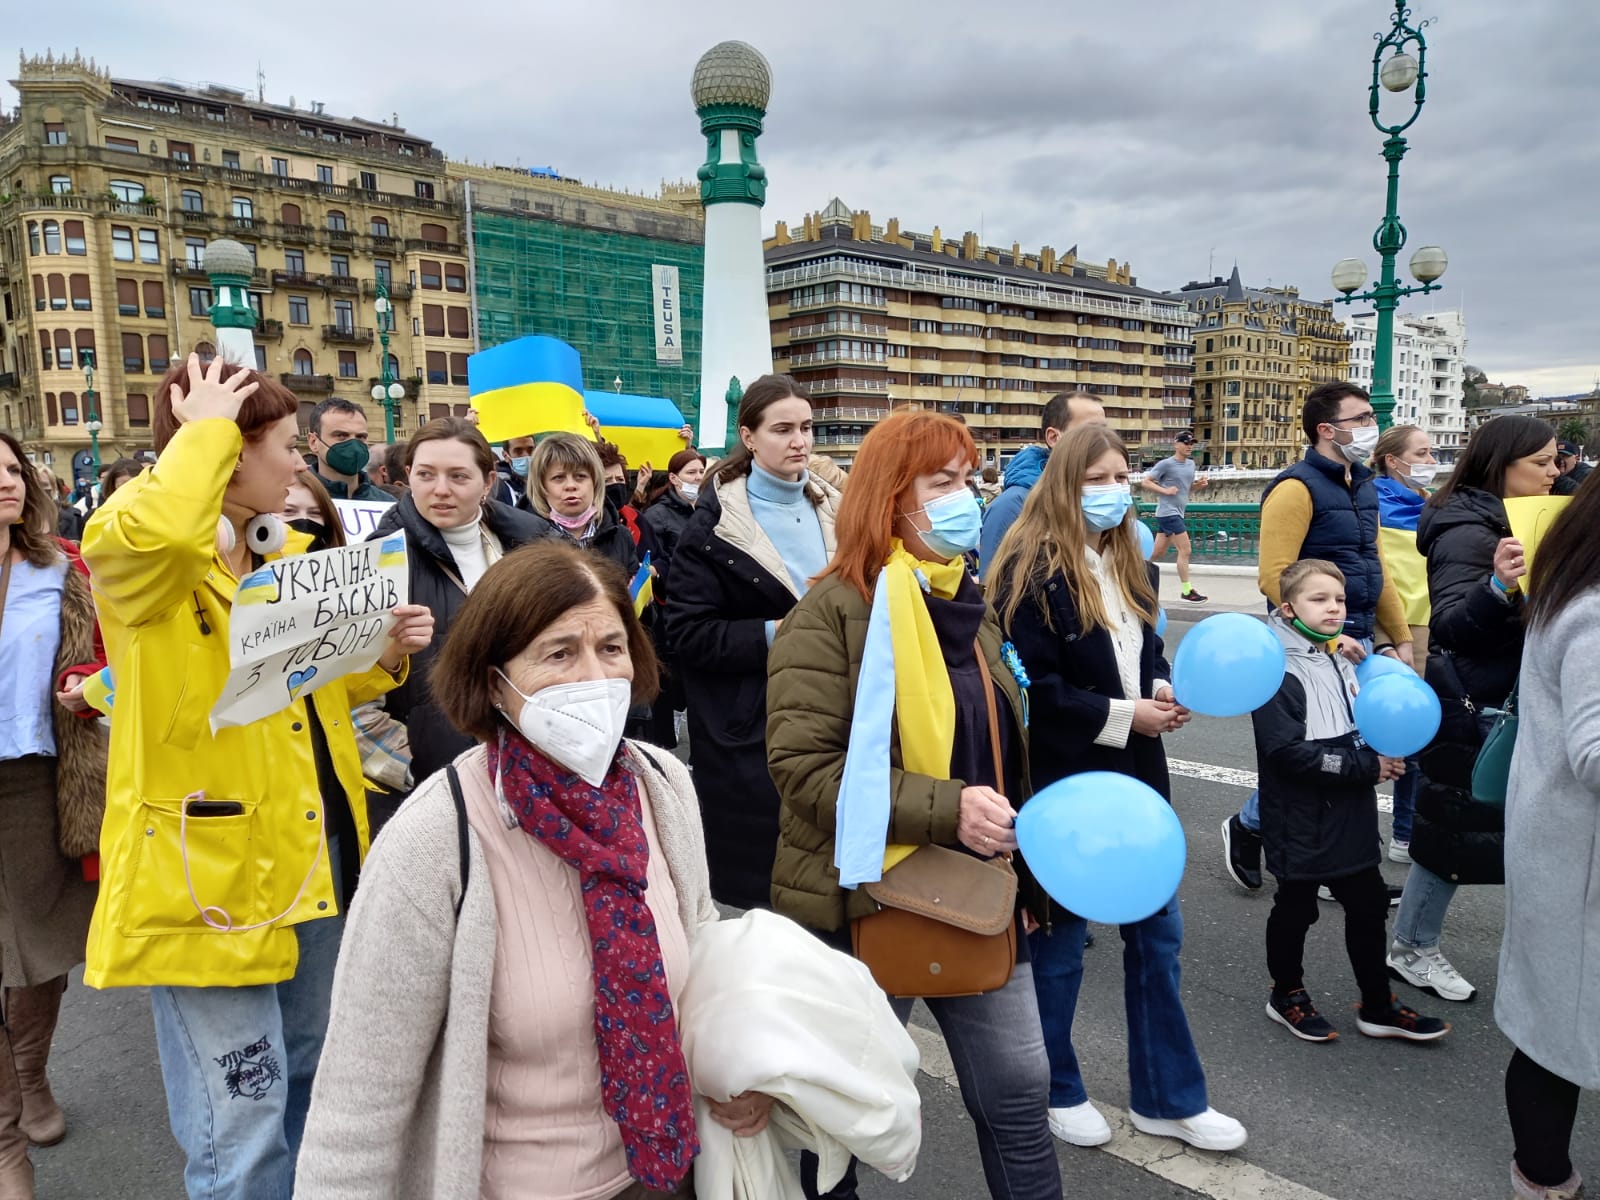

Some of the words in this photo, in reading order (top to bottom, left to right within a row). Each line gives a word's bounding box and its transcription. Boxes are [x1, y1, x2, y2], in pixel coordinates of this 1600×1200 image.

[661, 286, 675, 347] TEUSA
[241, 616, 296, 655] КРАЇНА
[314, 576, 399, 629] БАСКІВ
[236, 662, 266, 697] З
[282, 618, 383, 673] ТОБОЮ
